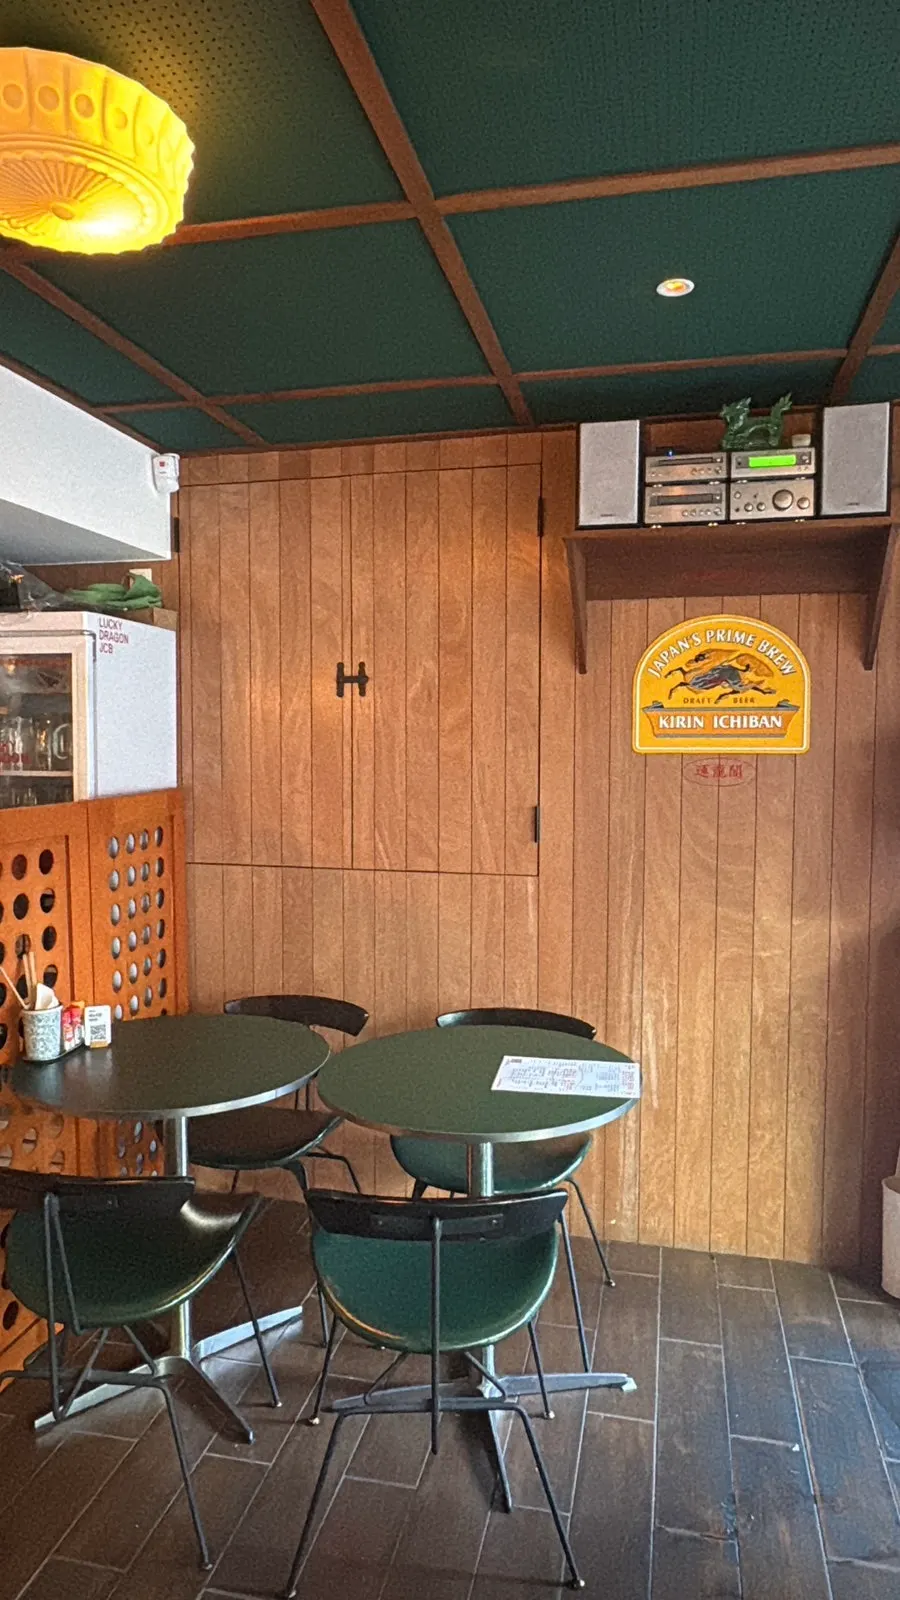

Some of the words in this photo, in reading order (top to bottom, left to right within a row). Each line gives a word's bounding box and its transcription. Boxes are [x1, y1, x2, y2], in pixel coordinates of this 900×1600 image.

[98, 617, 123, 631] LUCKY
[98, 630, 129, 644] DRAGON
[99, 643, 113, 654] JCB
[647, 632, 702, 678] JAPAN'S
[706, 628, 757, 647] PRIME
[758, 639, 797, 676] BREW
[658, 715, 704, 729] KIRIN
[713, 715, 782, 729] ICHIBAN
